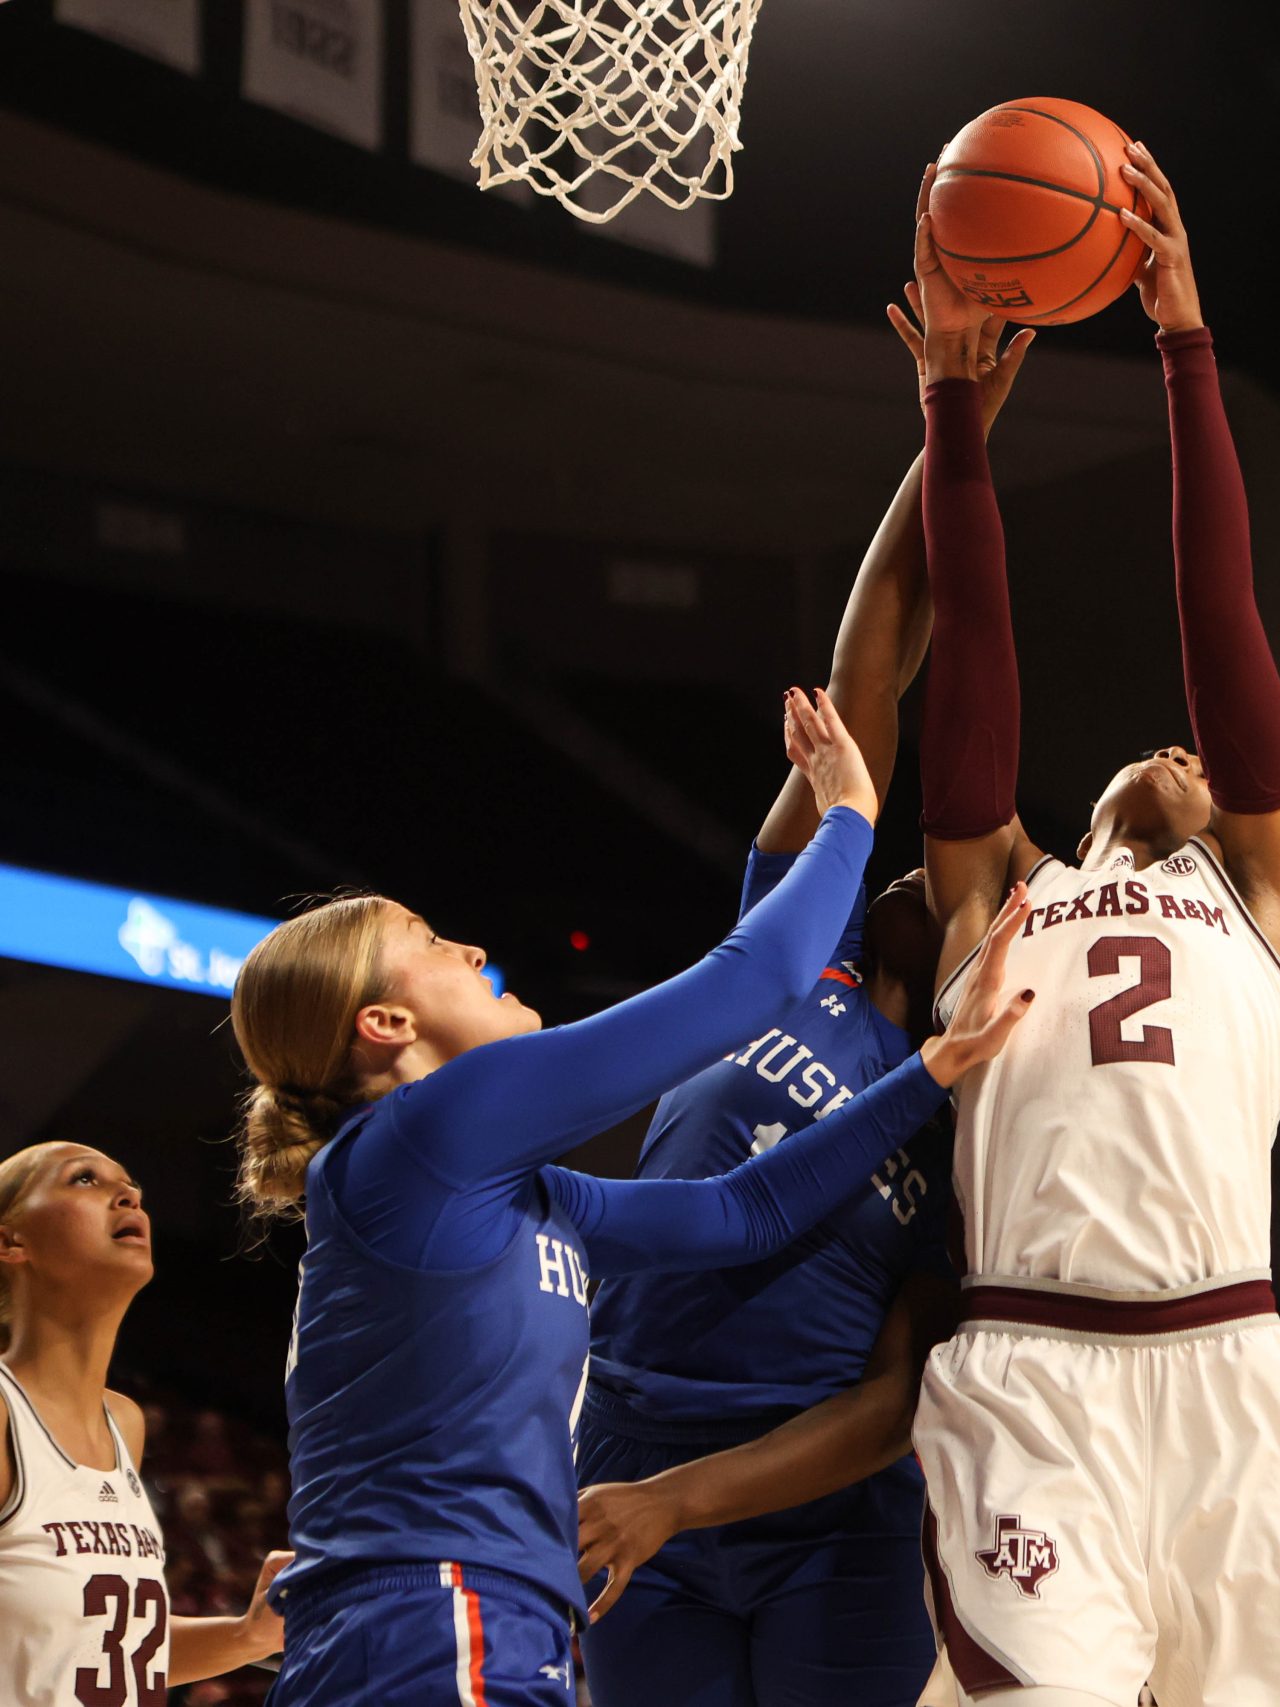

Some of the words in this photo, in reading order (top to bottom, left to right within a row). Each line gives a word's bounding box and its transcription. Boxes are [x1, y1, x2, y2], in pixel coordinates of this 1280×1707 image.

[1164, 857, 1193, 876] SEC
[1022, 881, 1149, 938] TEXAS
[1156, 895, 1230, 936] A&M
[1087, 936, 1175, 1067] 2
[42, 1521, 131, 1557] TEXAS
[130, 1524, 164, 1562] A&M
[75, 1574, 167, 1707] 32
